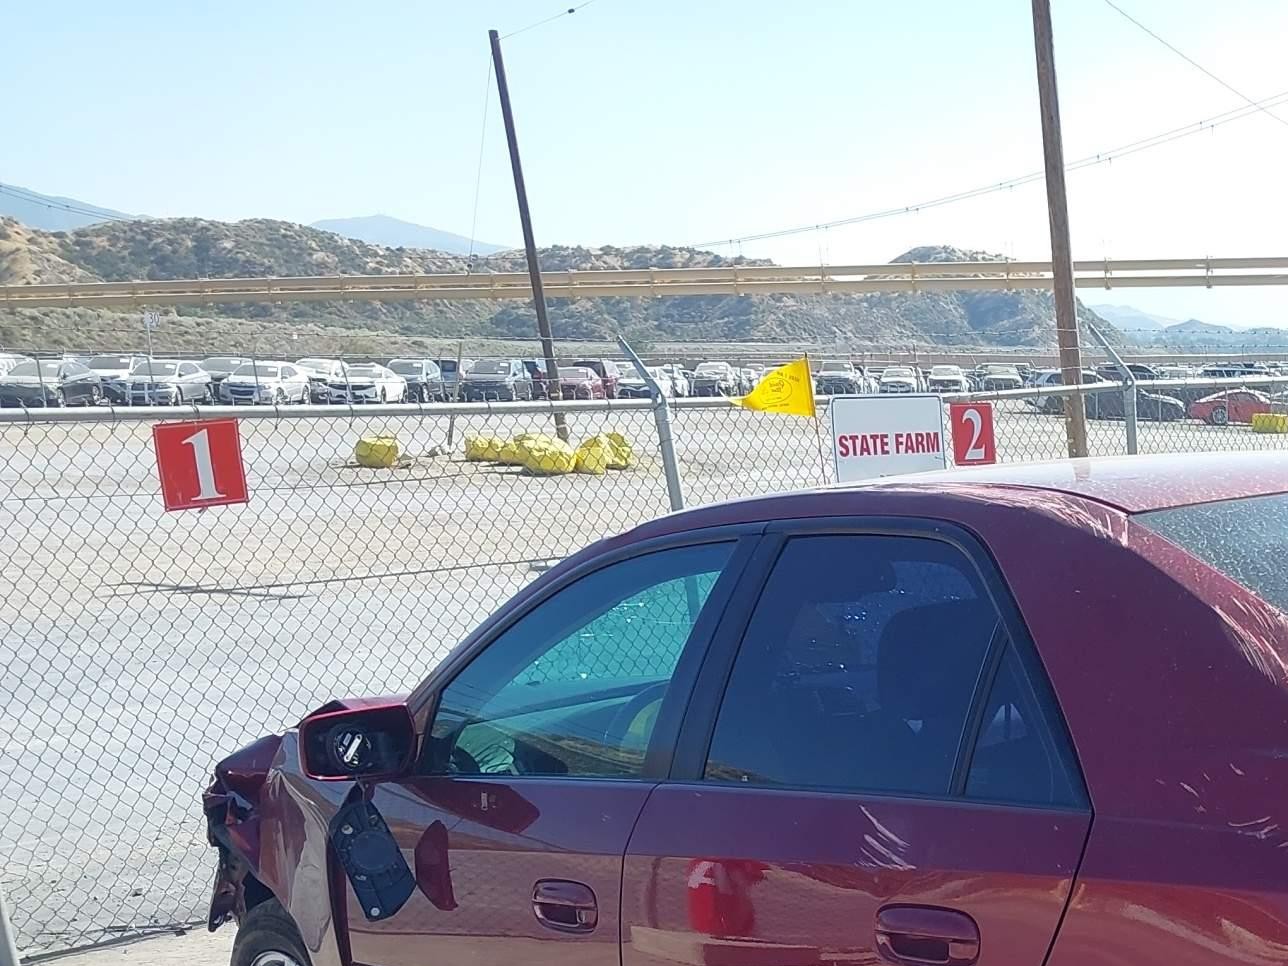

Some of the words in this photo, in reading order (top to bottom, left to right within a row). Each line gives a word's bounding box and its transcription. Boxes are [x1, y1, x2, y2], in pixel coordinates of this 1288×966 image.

[838, 434, 890, 458] STATE
[895, 431, 941, 455] FARM
[962, 408, 986, 460] 2
[181, 428, 227, 501] 1
